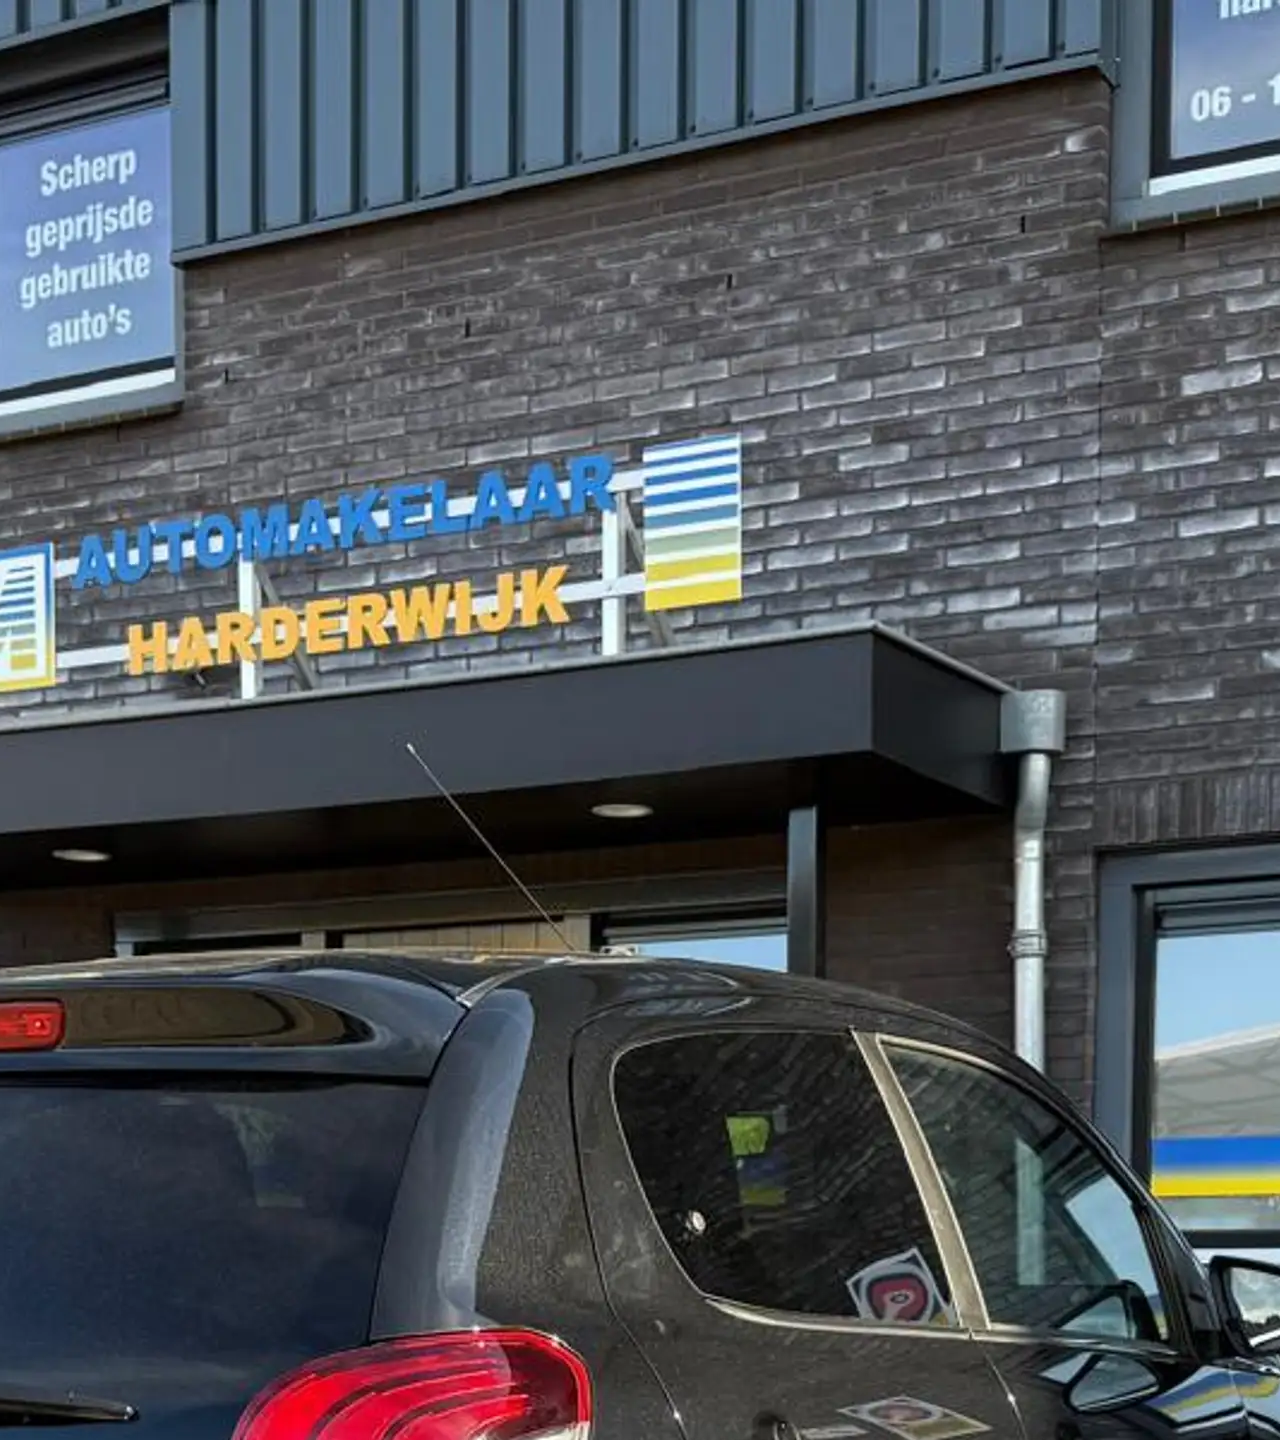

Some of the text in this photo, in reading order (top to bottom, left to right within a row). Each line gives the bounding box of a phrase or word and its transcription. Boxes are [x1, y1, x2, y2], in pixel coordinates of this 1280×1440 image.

[1191, 86, 1231, 121] 06
[40, 149, 137, 196] Scherp
[25, 195, 154, 258] geprijsde
[20, 249, 151, 310] gebruikte
[47, 303, 133, 348] auto's
[71, 453, 616, 590] AUTOMAKELAAR
[127, 565, 570, 675] HARDERWIJK
